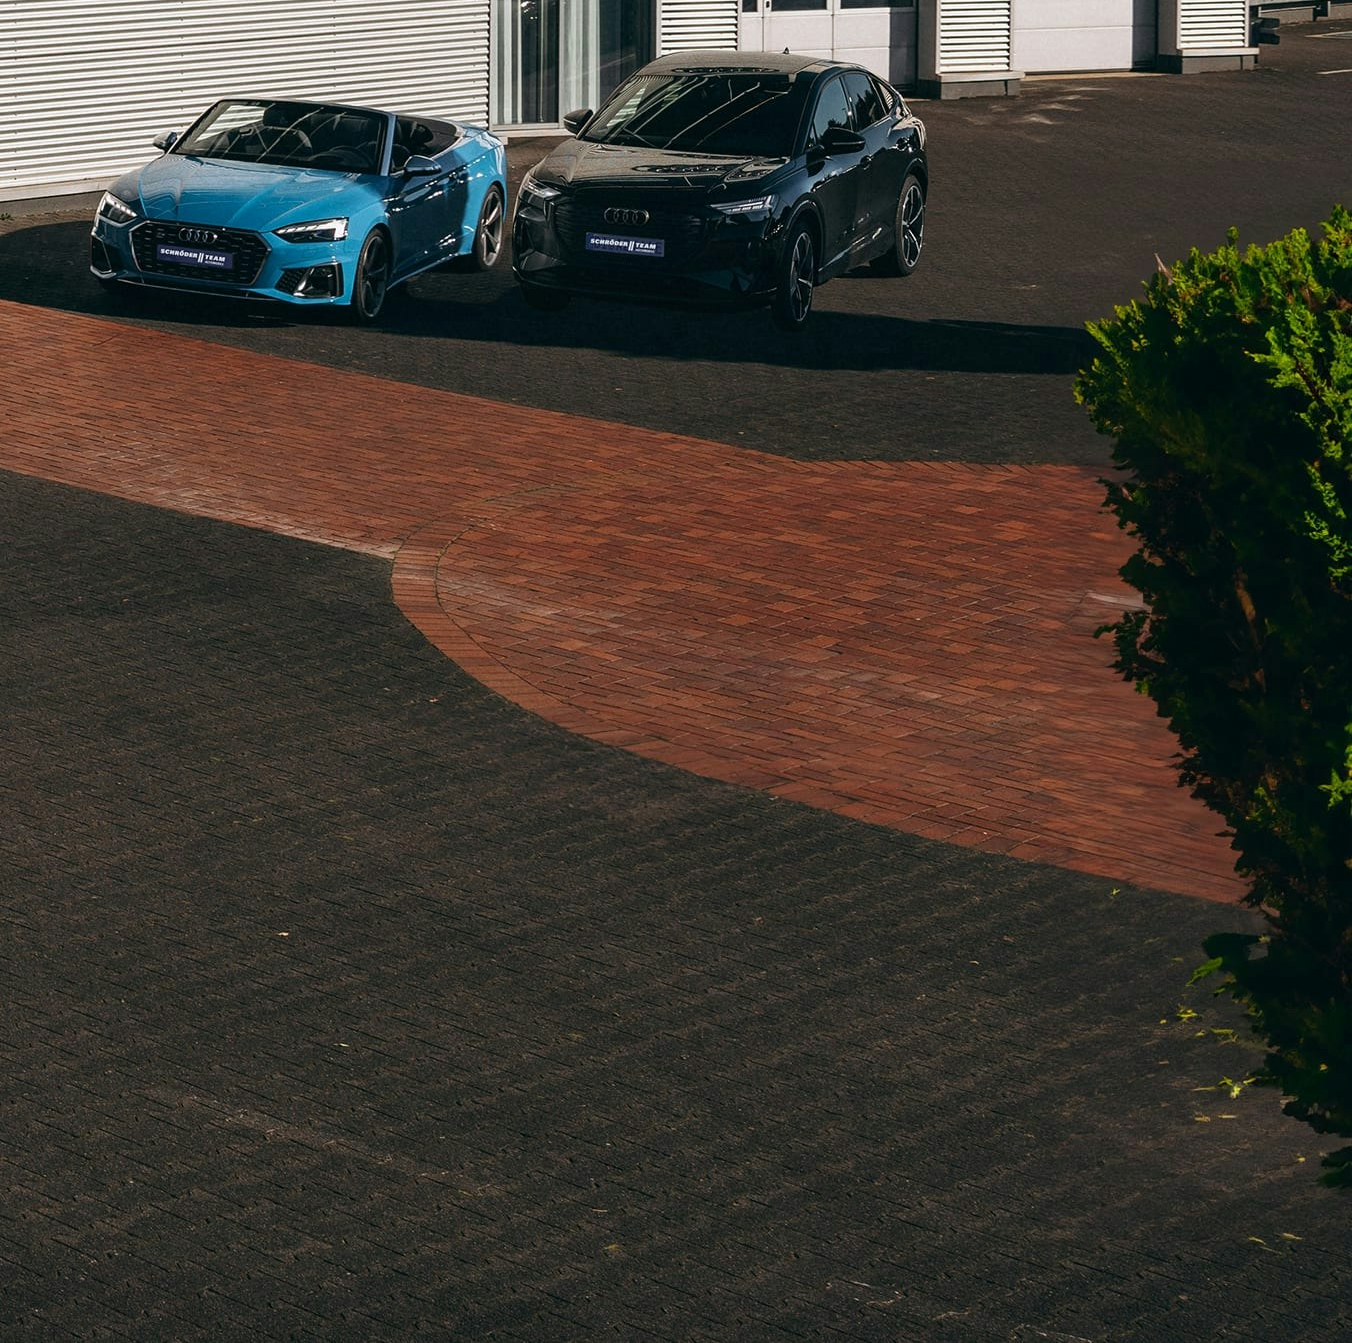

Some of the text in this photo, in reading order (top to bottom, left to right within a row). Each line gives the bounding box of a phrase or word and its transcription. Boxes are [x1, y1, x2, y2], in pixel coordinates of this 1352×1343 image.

[590, 238, 657, 250] SCHRÖDER TEAM
[160, 248, 226, 262] SCHRÖDER TEAM
